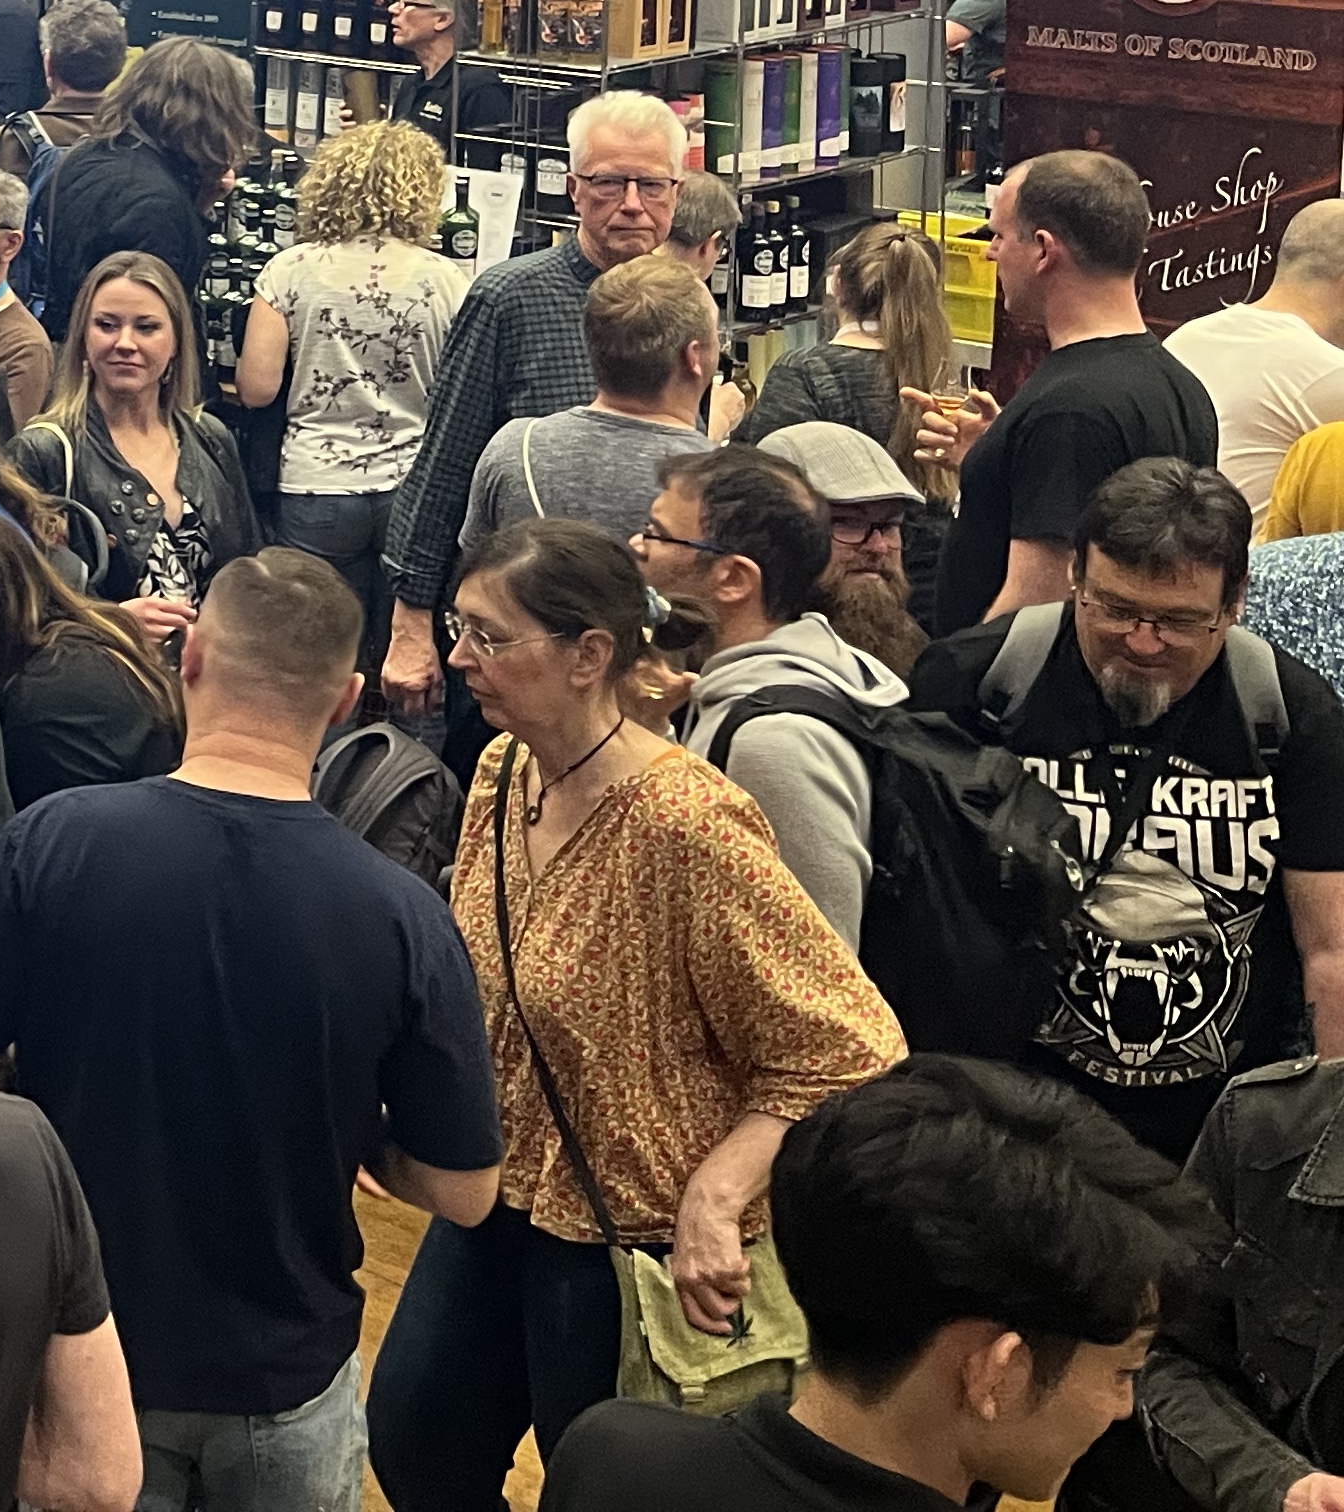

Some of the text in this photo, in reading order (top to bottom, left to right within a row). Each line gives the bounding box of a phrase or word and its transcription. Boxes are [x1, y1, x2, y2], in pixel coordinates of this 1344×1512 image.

[1026, 25, 1317, 71] MALTS OF SCOTLAND
[1211, 147, 1284, 234] Shop
[1148, 243, 1272, 307] Tastings
[1151, 774, 1276, 818] KRAFT
[1067, 1049, 1202, 1086] FESTIVAL
